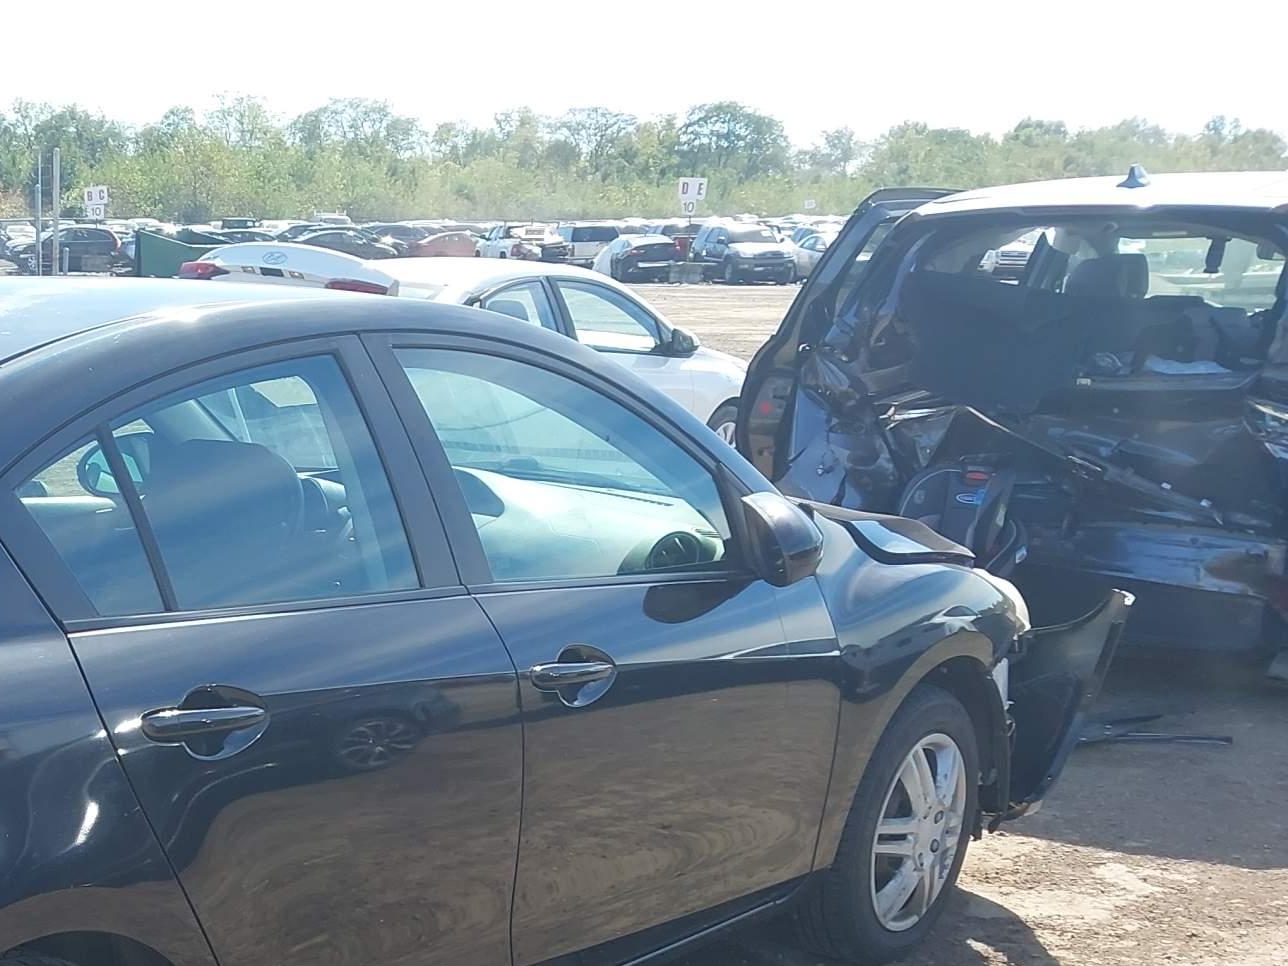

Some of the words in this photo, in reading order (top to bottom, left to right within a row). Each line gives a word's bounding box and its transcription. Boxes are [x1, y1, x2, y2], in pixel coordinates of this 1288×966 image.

[87, 190, 93, 201] B
[98, 189, 105, 200] C
[682, 182, 689, 195] D
[697, 182, 705, 196] E
[92, 206, 102, 217] 10
[683, 201, 695, 213] 10
